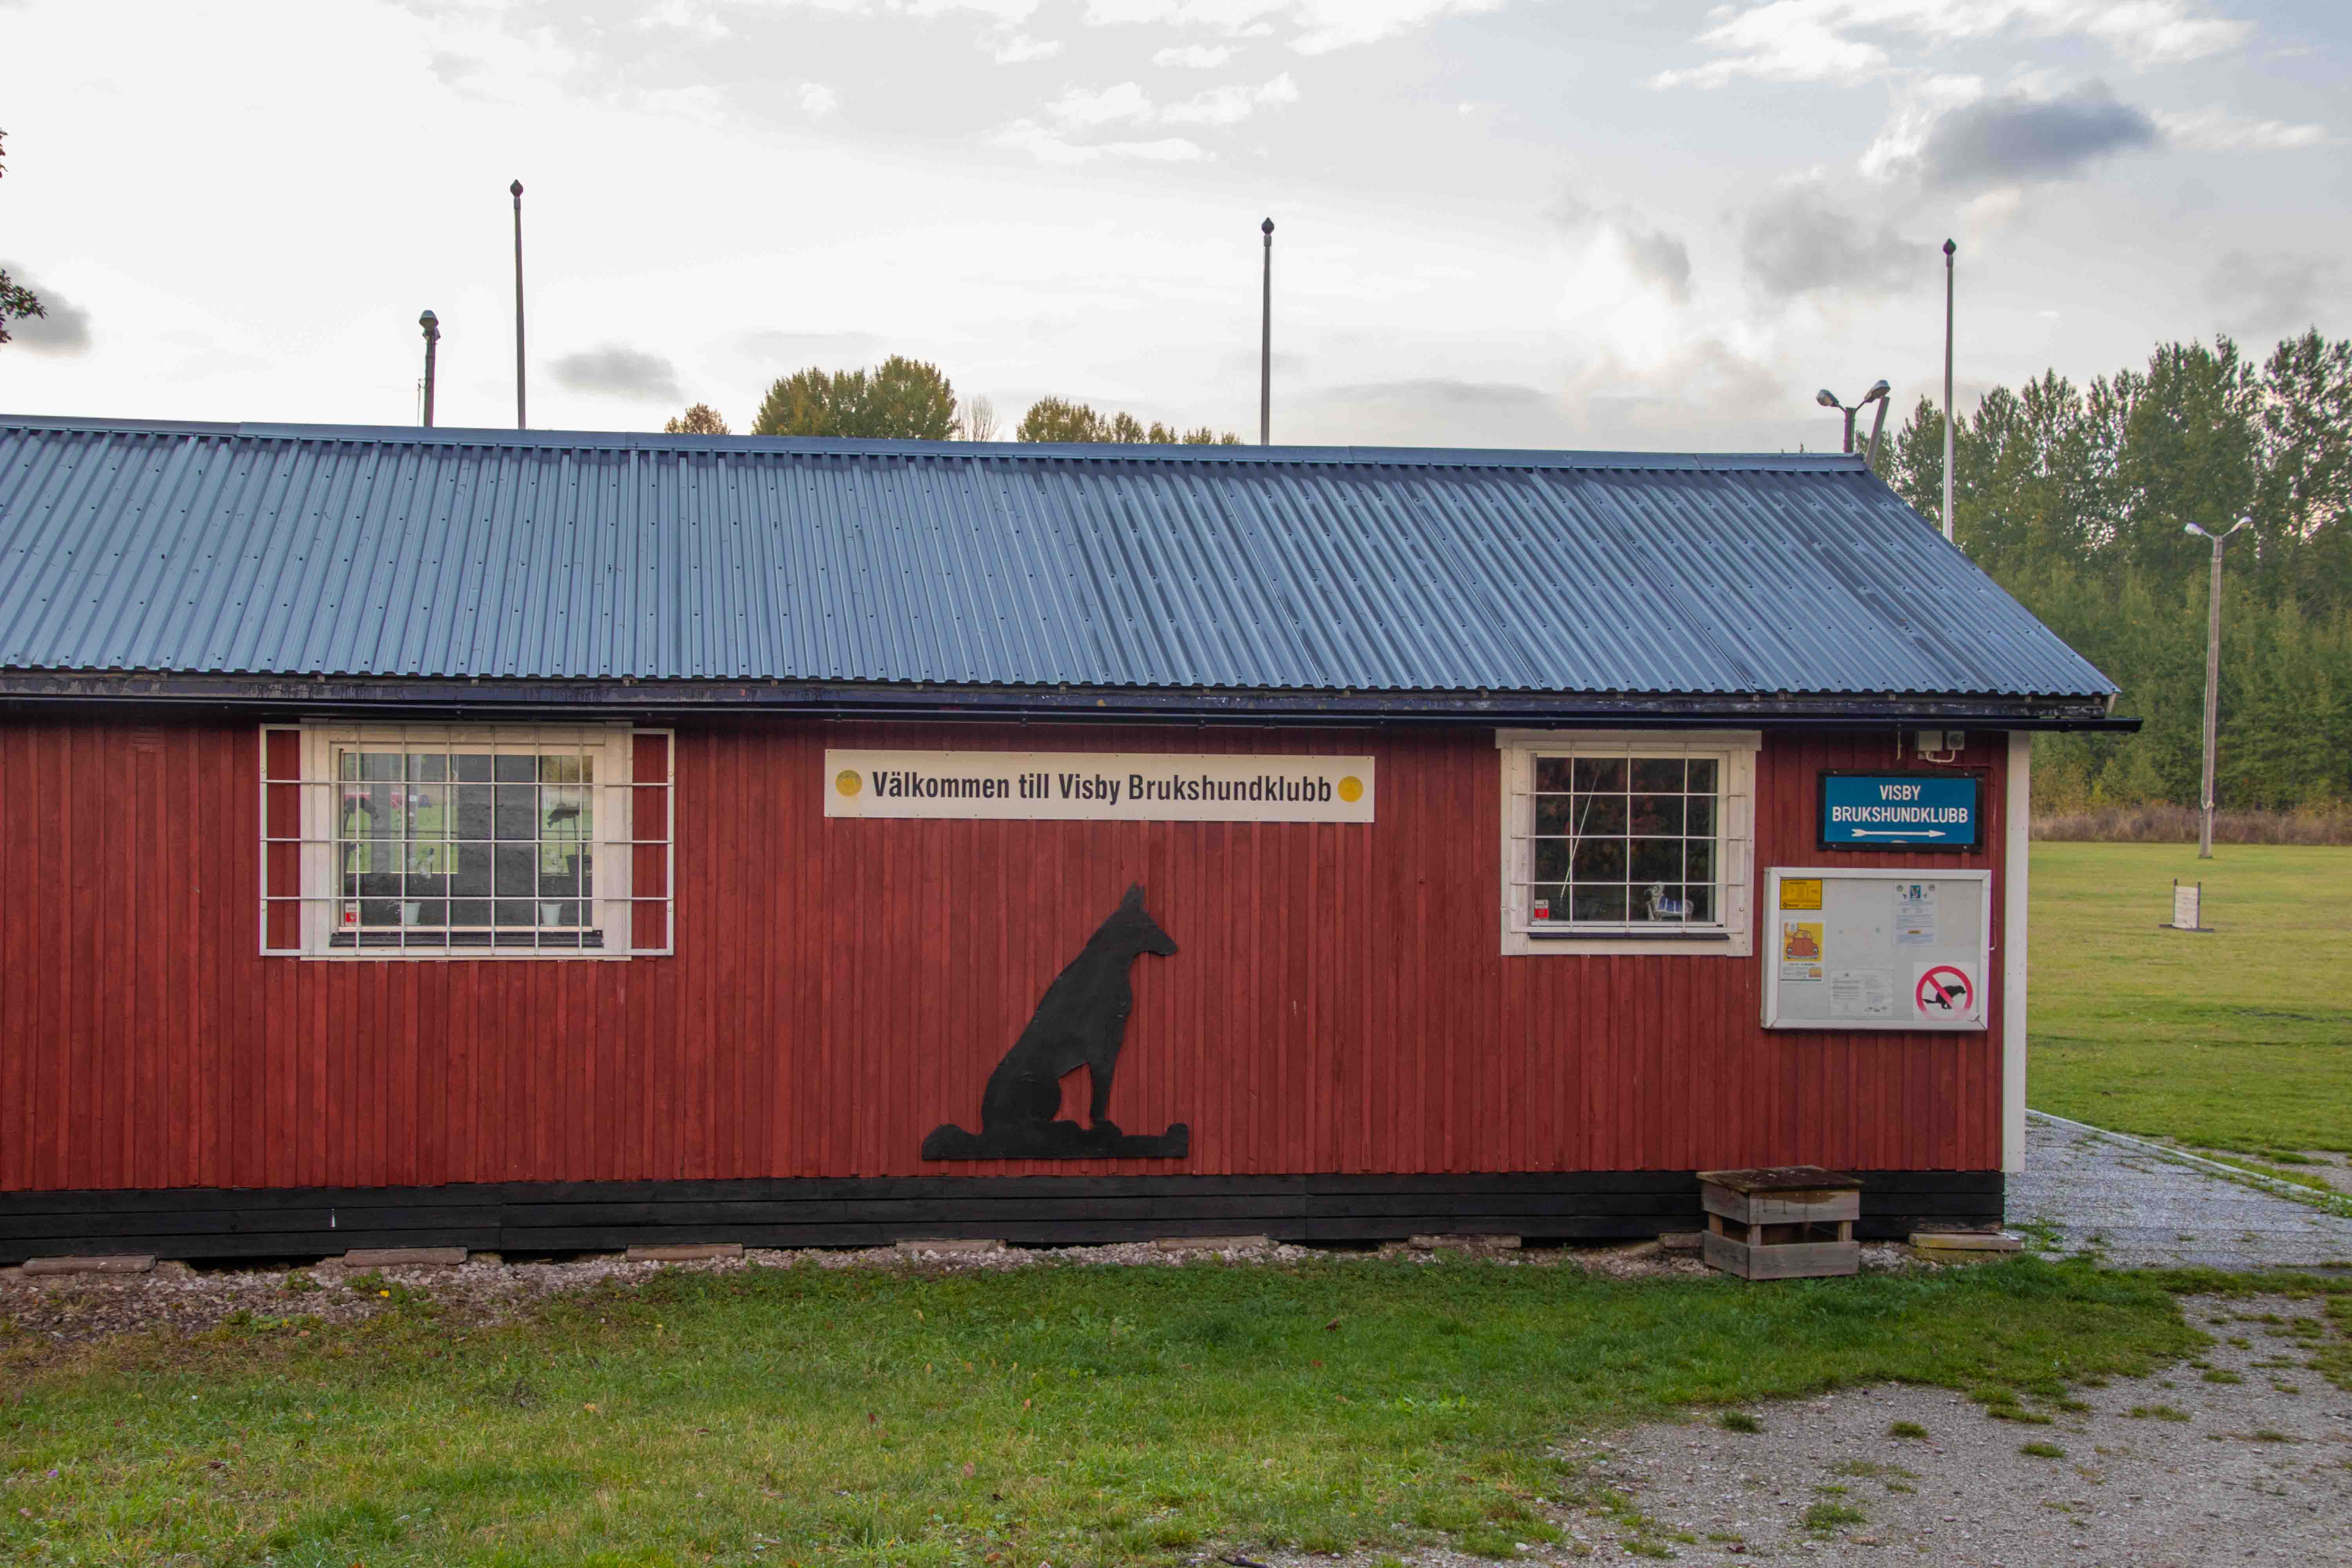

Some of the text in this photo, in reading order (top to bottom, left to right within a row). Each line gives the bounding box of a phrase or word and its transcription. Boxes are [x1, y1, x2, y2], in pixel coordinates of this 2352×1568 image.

[872, 771, 1331, 806] Välkommen till Visby Brukshundklubb
[1879, 785, 1921, 800] VISBY
[1832, 806, 1968, 823] BRUKSHUNDKLUBB
